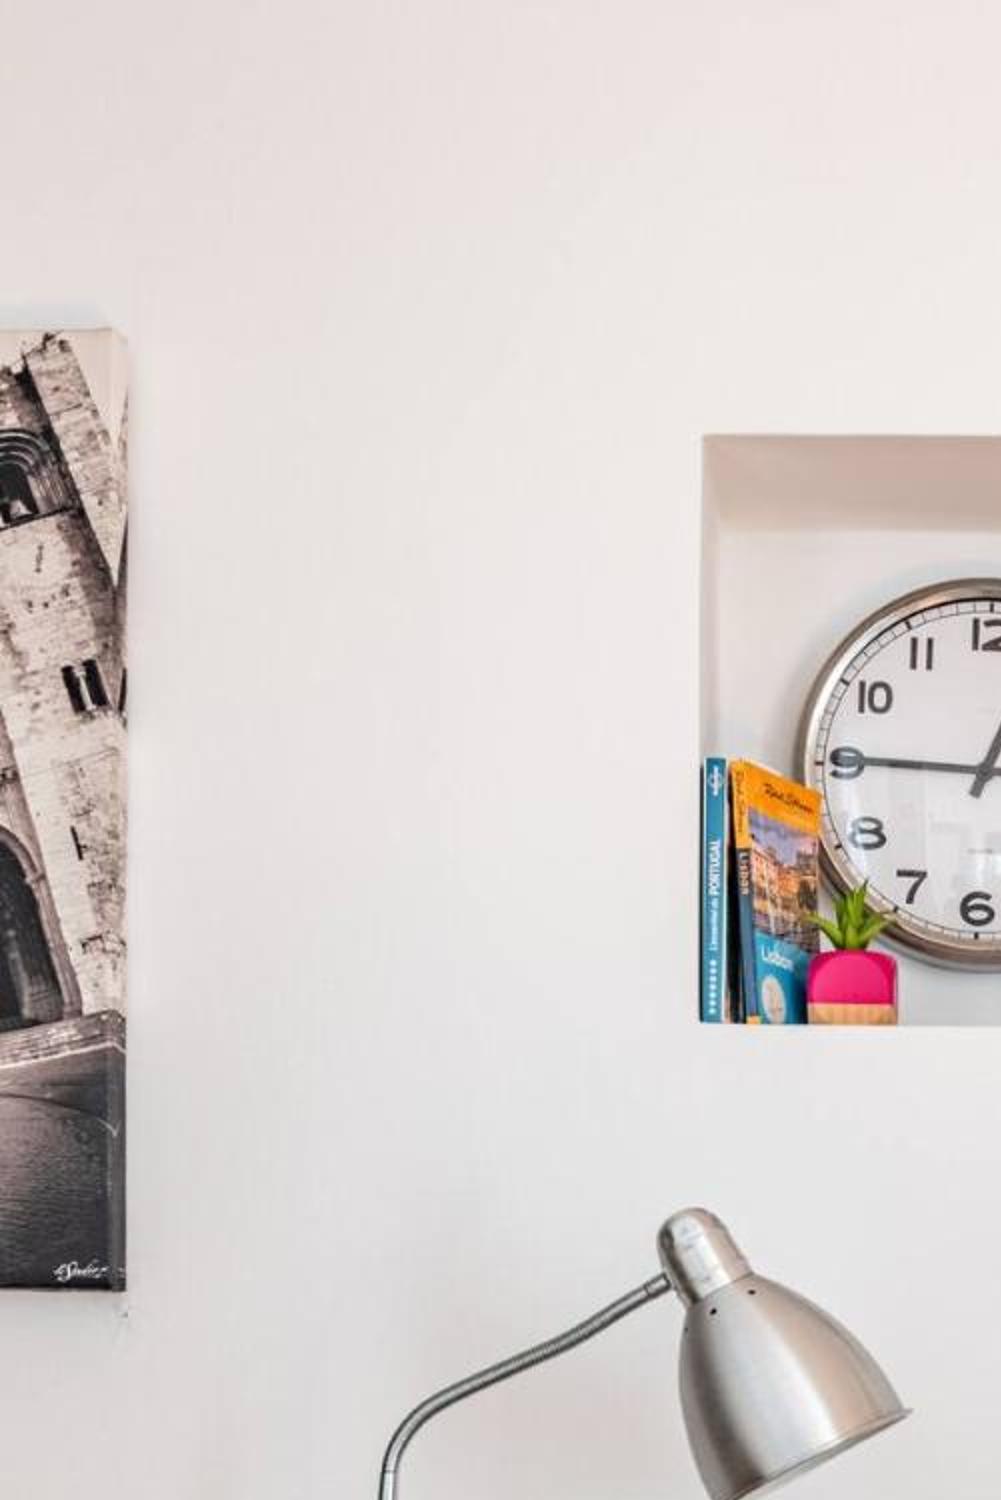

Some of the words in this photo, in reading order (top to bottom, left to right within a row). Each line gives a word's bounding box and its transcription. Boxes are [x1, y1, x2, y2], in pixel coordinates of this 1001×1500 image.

[909, 636, 934, 671] 11
[857, 681, 893, 714] 10
[830, 746, 866, 779] 9
[849, 817, 887, 850] 8
[708, 839, 721, 896] PORTUGAL
[896, 869, 928, 904] 7
[959, 891, 995, 926] 6
